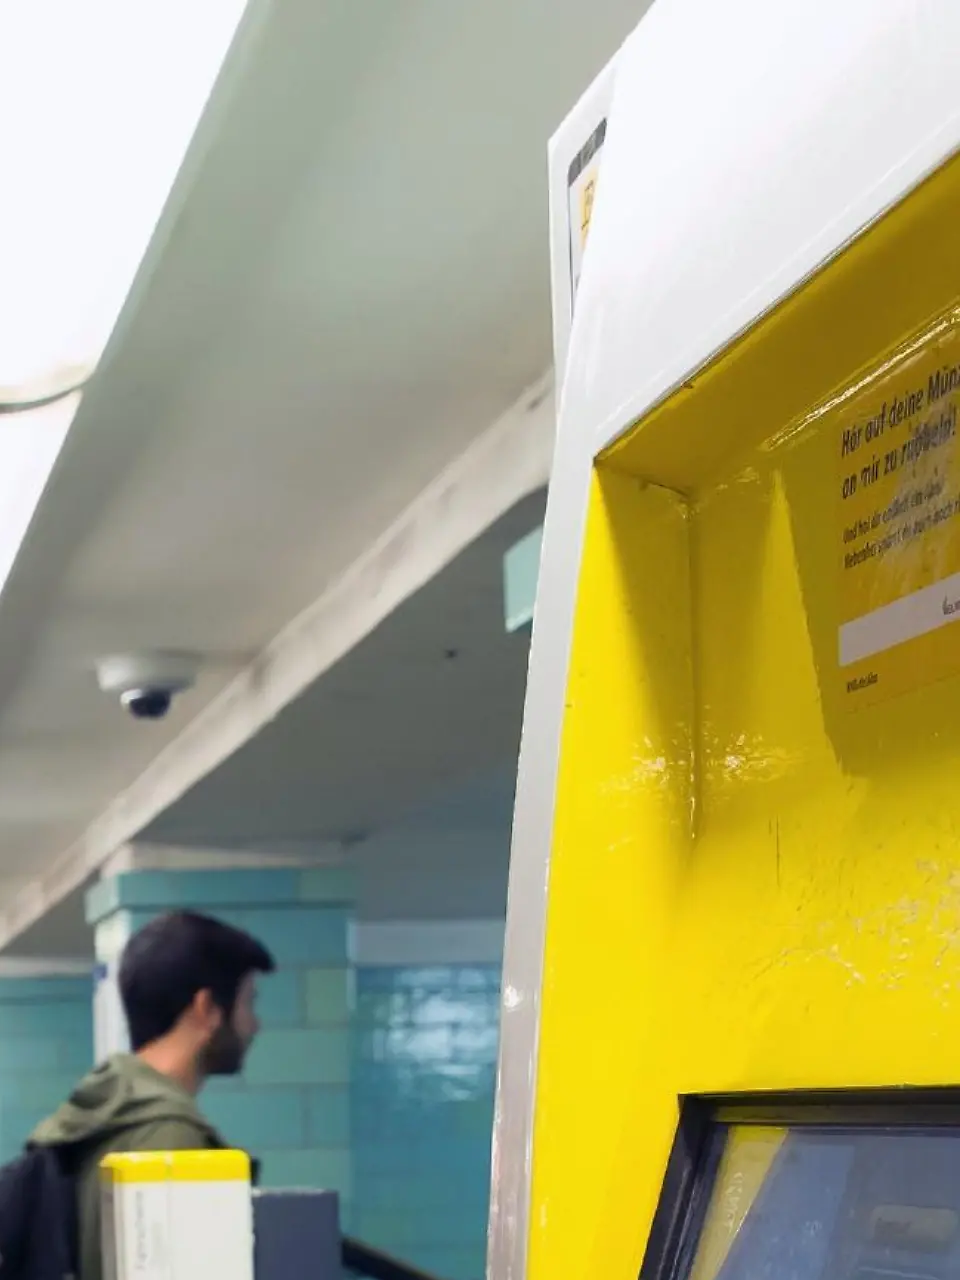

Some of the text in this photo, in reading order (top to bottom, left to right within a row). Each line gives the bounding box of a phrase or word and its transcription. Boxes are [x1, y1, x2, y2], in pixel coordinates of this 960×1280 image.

[842, 363, 960, 458] Hör auf deine Mün
[842, 473, 857, 500] an
[860, 454, 881, 487] mir
[884, 449, 898, 476] zu
